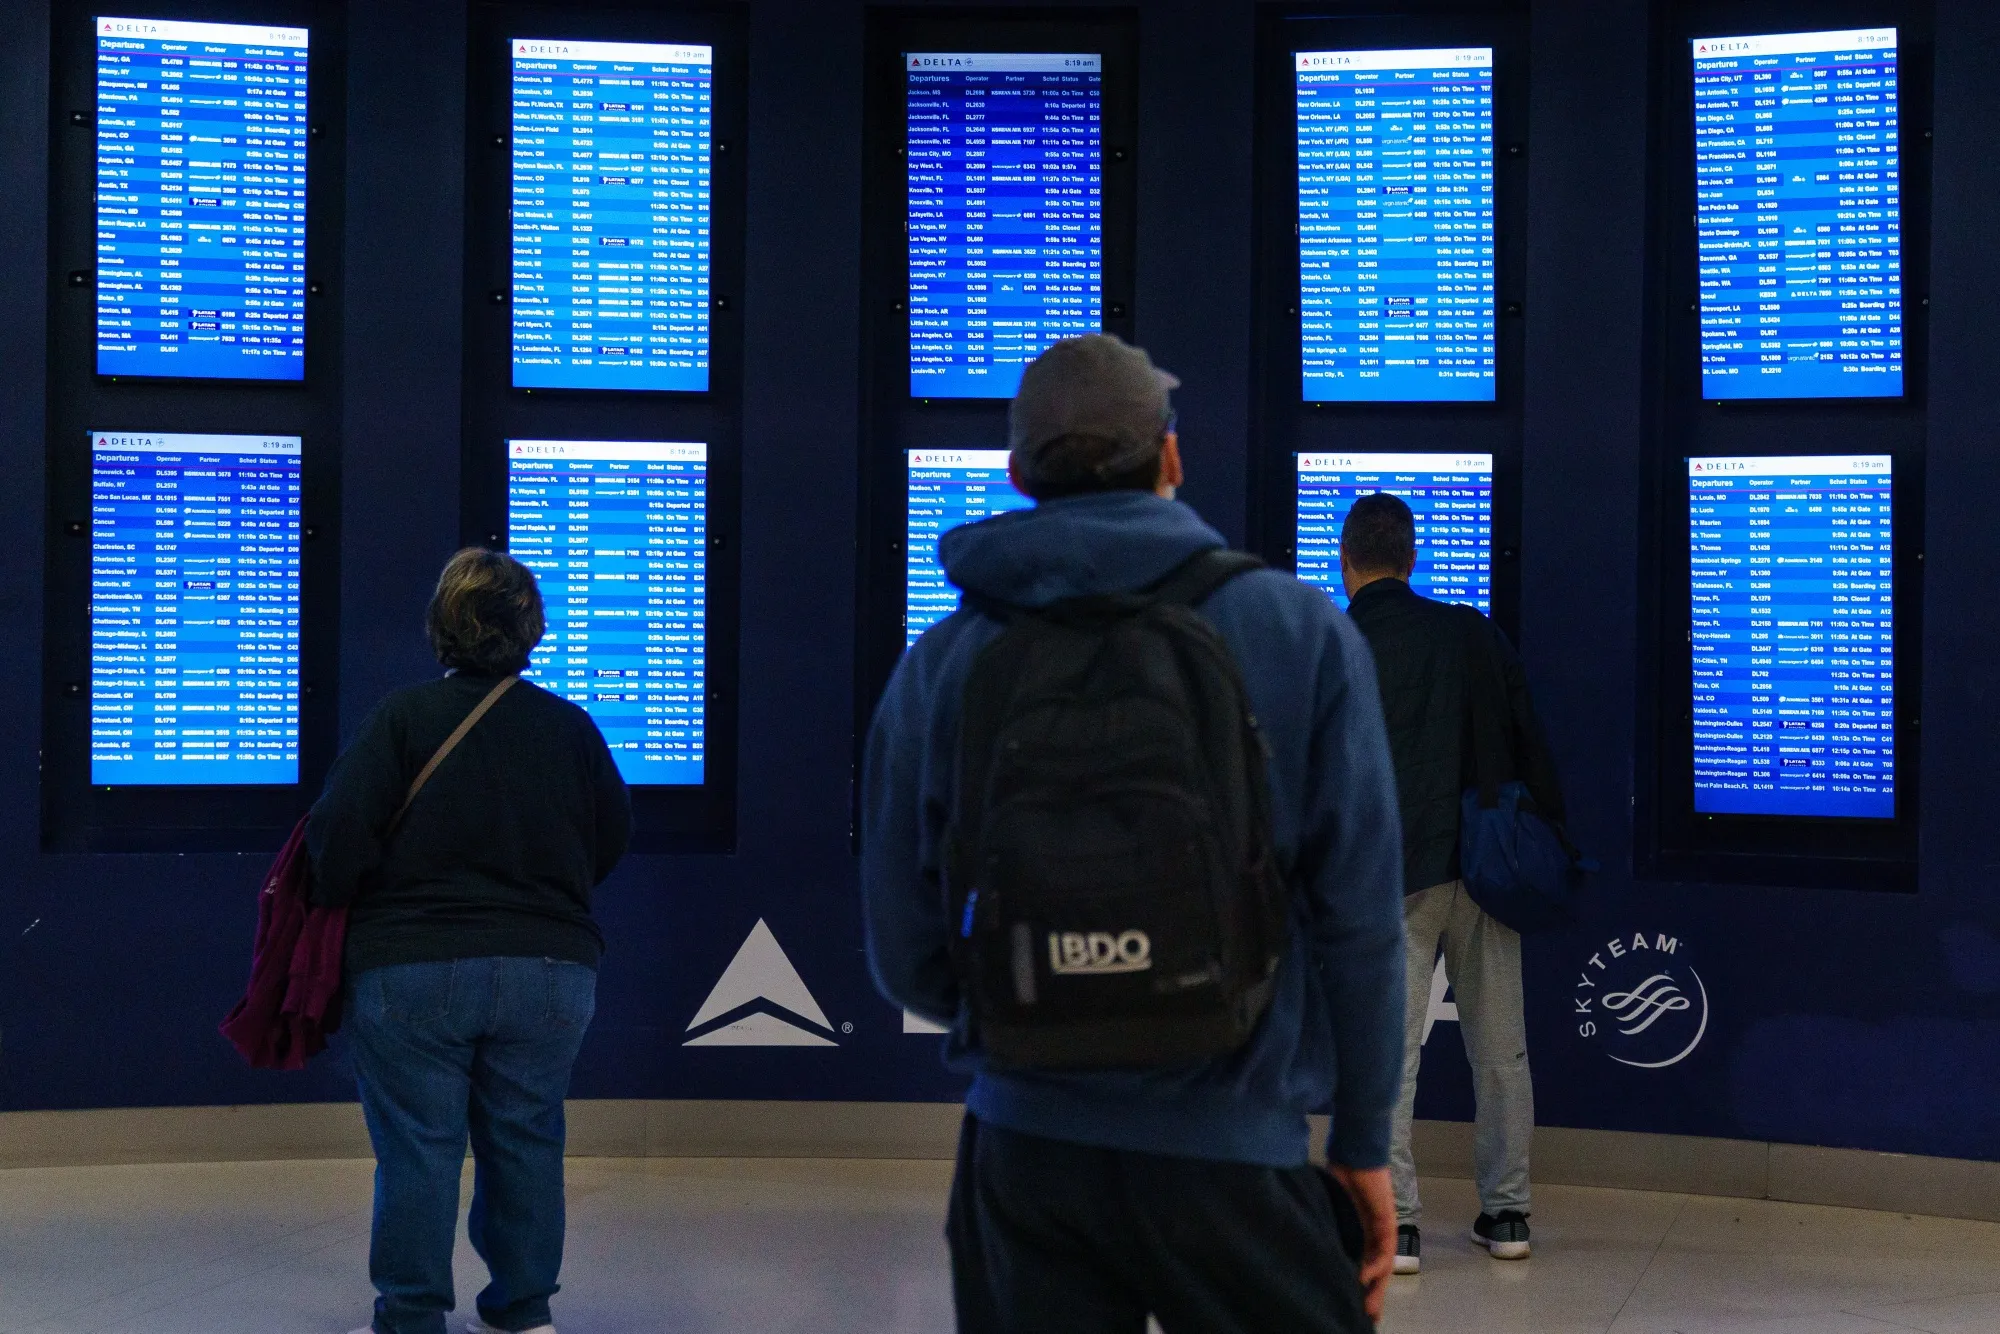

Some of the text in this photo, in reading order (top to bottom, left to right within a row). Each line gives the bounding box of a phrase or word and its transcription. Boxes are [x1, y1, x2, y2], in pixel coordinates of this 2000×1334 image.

[116, 24, 157, 32] DELTA
[100, 40, 145, 51] Departures
[530, 45, 568, 53] DELTA
[1711, 43, 1749, 52] DELTA
[515, 61, 557, 70] Departures
[924, 58, 961, 66] DELTA
[1313, 57, 1350, 65] DELTA
[1697, 61, 1738, 70] Departures
[910, 75, 950, 83] Departures
[1299, 74, 1339, 83] Departures
[96, 454, 139, 462] Departures
[512, 461, 553, 470] Departures
[911, 471, 951, 479] Departures
[1300, 474, 1340, 483] Departures
[1692, 479, 1733, 488] Departures
[1060, 929, 1151, 966] BDO
[1575, 932, 1678, 1038] SKYTEAM
